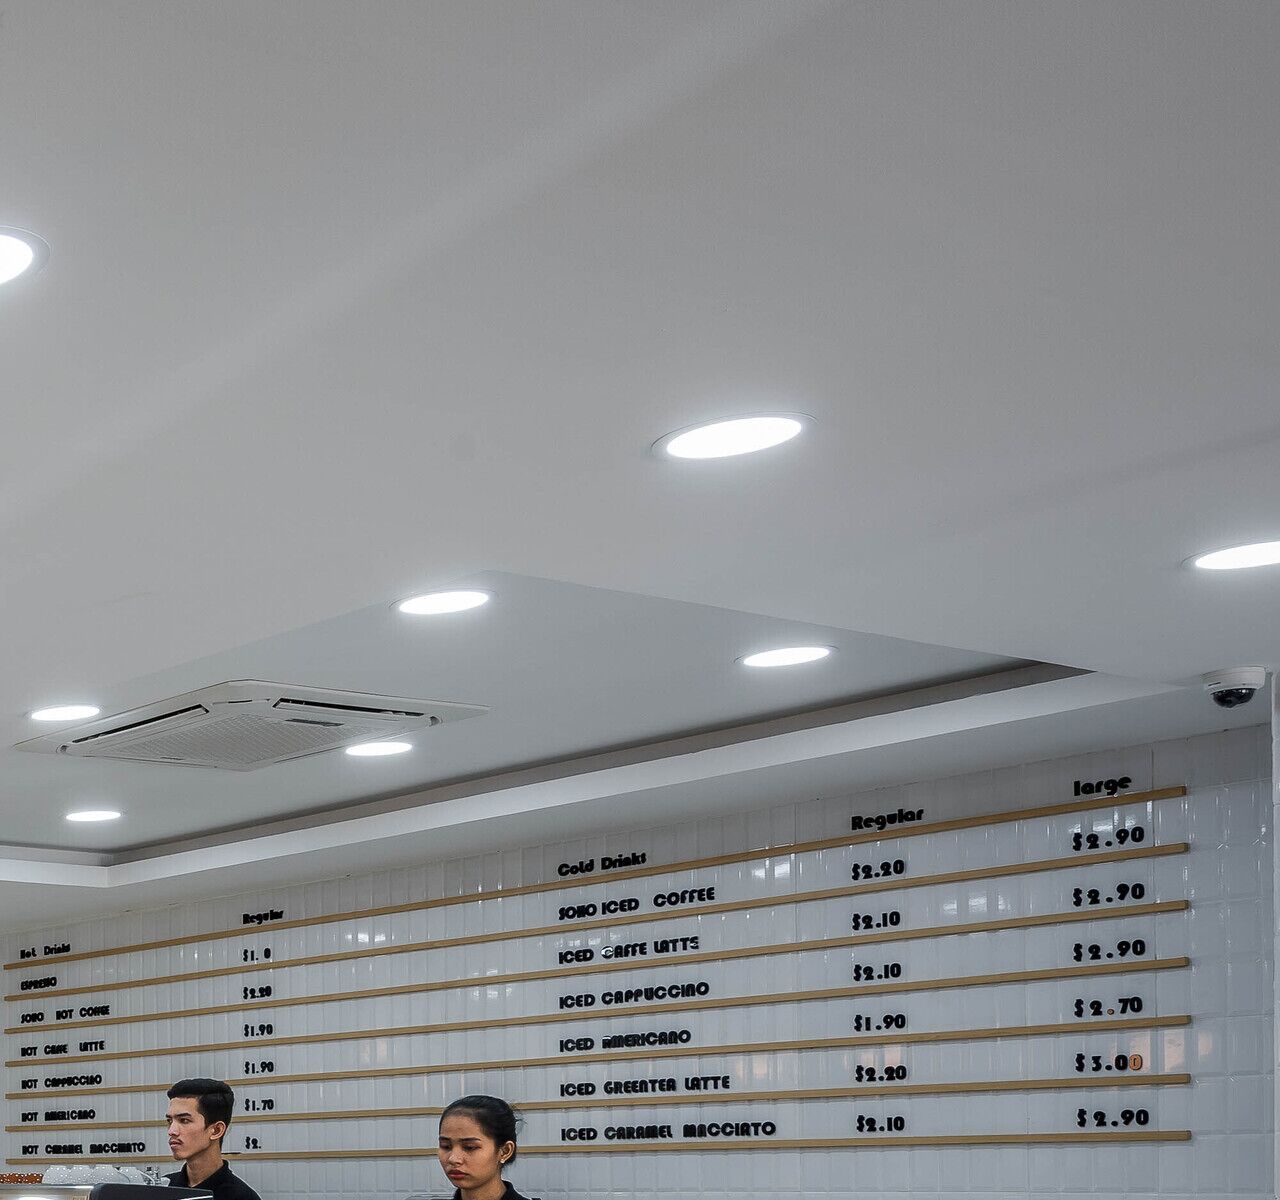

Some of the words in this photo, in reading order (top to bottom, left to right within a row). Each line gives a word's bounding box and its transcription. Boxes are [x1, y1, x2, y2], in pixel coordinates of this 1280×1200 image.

[1073, 775, 1132, 797] large
[851, 808, 925, 832] Regular
[1072, 826, 1145, 852] $2.90
[558, 858, 594, 877] Cold
[601, 852, 647, 871] Drinks
[851, 859, 905, 881] $2.20
[558, 903, 597, 921] SOHO
[601, 898, 640, 915] ICED
[653, 887, 715, 907] COFFEE
[1072, 882, 1145, 907] $2.90
[243, 909, 284, 925] Regular
[852, 910, 901, 931] $2.10
[44, 943, 70, 956] Drinks
[559, 948, 594, 964] ICED
[601, 942, 647, 960] CAFFE
[653, 936, 699, 953] LATTE
[1073, 938, 1146, 962] $2.90
[853, 962, 902, 982] $2.10
[243, 986, 272, 1000] $2.20
[559, 993, 596, 1009] ICED
[601, 981, 710, 1005] CAPPUCCINO
[1073, 996, 1143, 1018] $2.70
[244, 1024, 273, 1037] $1.90
[853, 1013, 906, 1032] $1.90
[559, 1037, 595, 1053] ICED
[602, 1029, 691, 1049] AMERICANO
[244, 1061, 274, 1074] $1.90
[1075, 1053, 1143, 1073] $3.00
[855, 1065, 907, 1083] $2.20
[560, 1082, 596, 1097] ICED
[684, 1075, 730, 1091] LATTE
[244, 1098, 274, 1111] $1.70
[856, 1115, 905, 1133] $2.10
[1077, 1108, 1149, 1128] $2.90
[561, 1127, 598, 1141] ICED
[604, 1125, 673, 1140] CARAMEL
